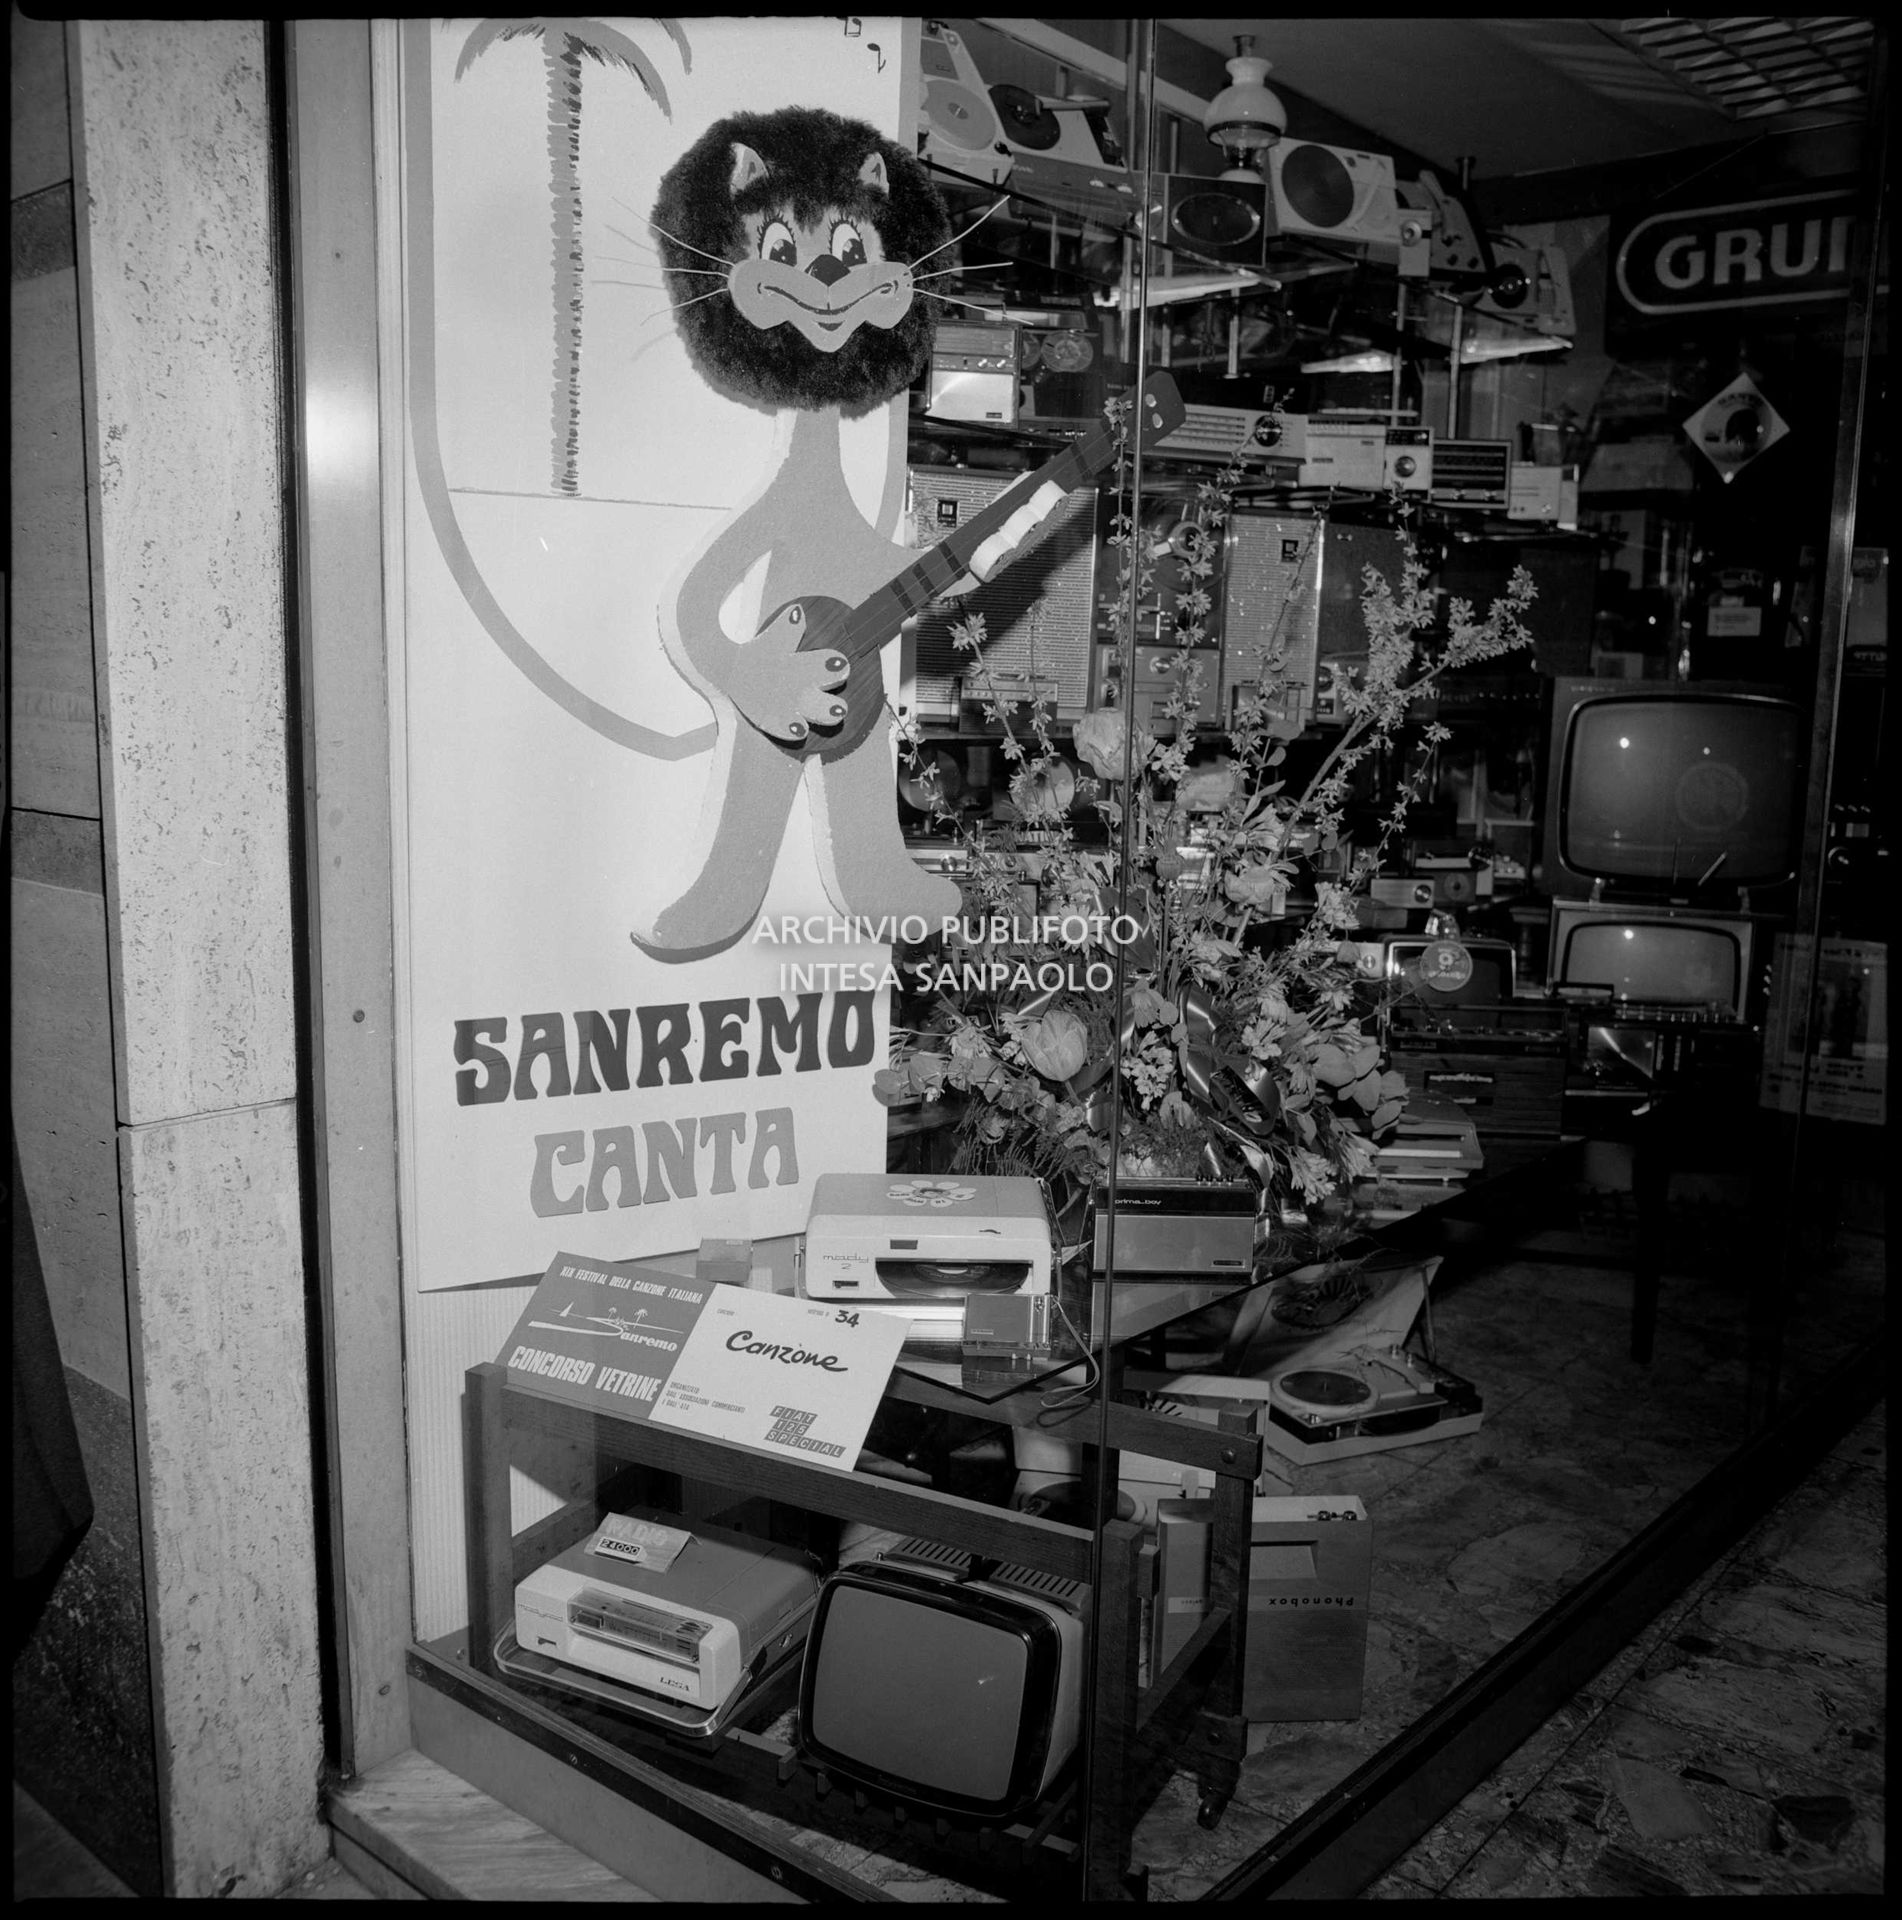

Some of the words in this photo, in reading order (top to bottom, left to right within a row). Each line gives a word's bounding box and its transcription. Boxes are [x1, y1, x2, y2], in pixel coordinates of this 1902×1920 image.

[453, 990, 876, 1106] SANREMO
[530, 1107, 799, 1218] CANTA
[575, 1269, 607, 1285] FESTIVAL
[609, 1276, 632, 1291] DELLA
[633, 1281, 667, 1297] CANZONE
[668, 1287, 703, 1304] ITALIANA
[835, 1310, 860, 1328] 34
[726, 1330, 848, 1373] Canzone
[508, 1345, 595, 1385] CONCORSO
[595, 1366, 662, 1402] VETRINE
[771, 1405, 817, 1424] FIAT
[774, 1419, 809, 1436] 125
[765, 1431, 846, 1458] SPECIAL
[606, 1517, 668, 1547] RADIO
[601, 1538, 641, 1556] 24000
[1269, 1597, 1354, 1607] phonobox
[660, 1676, 691, 1692] LESA
